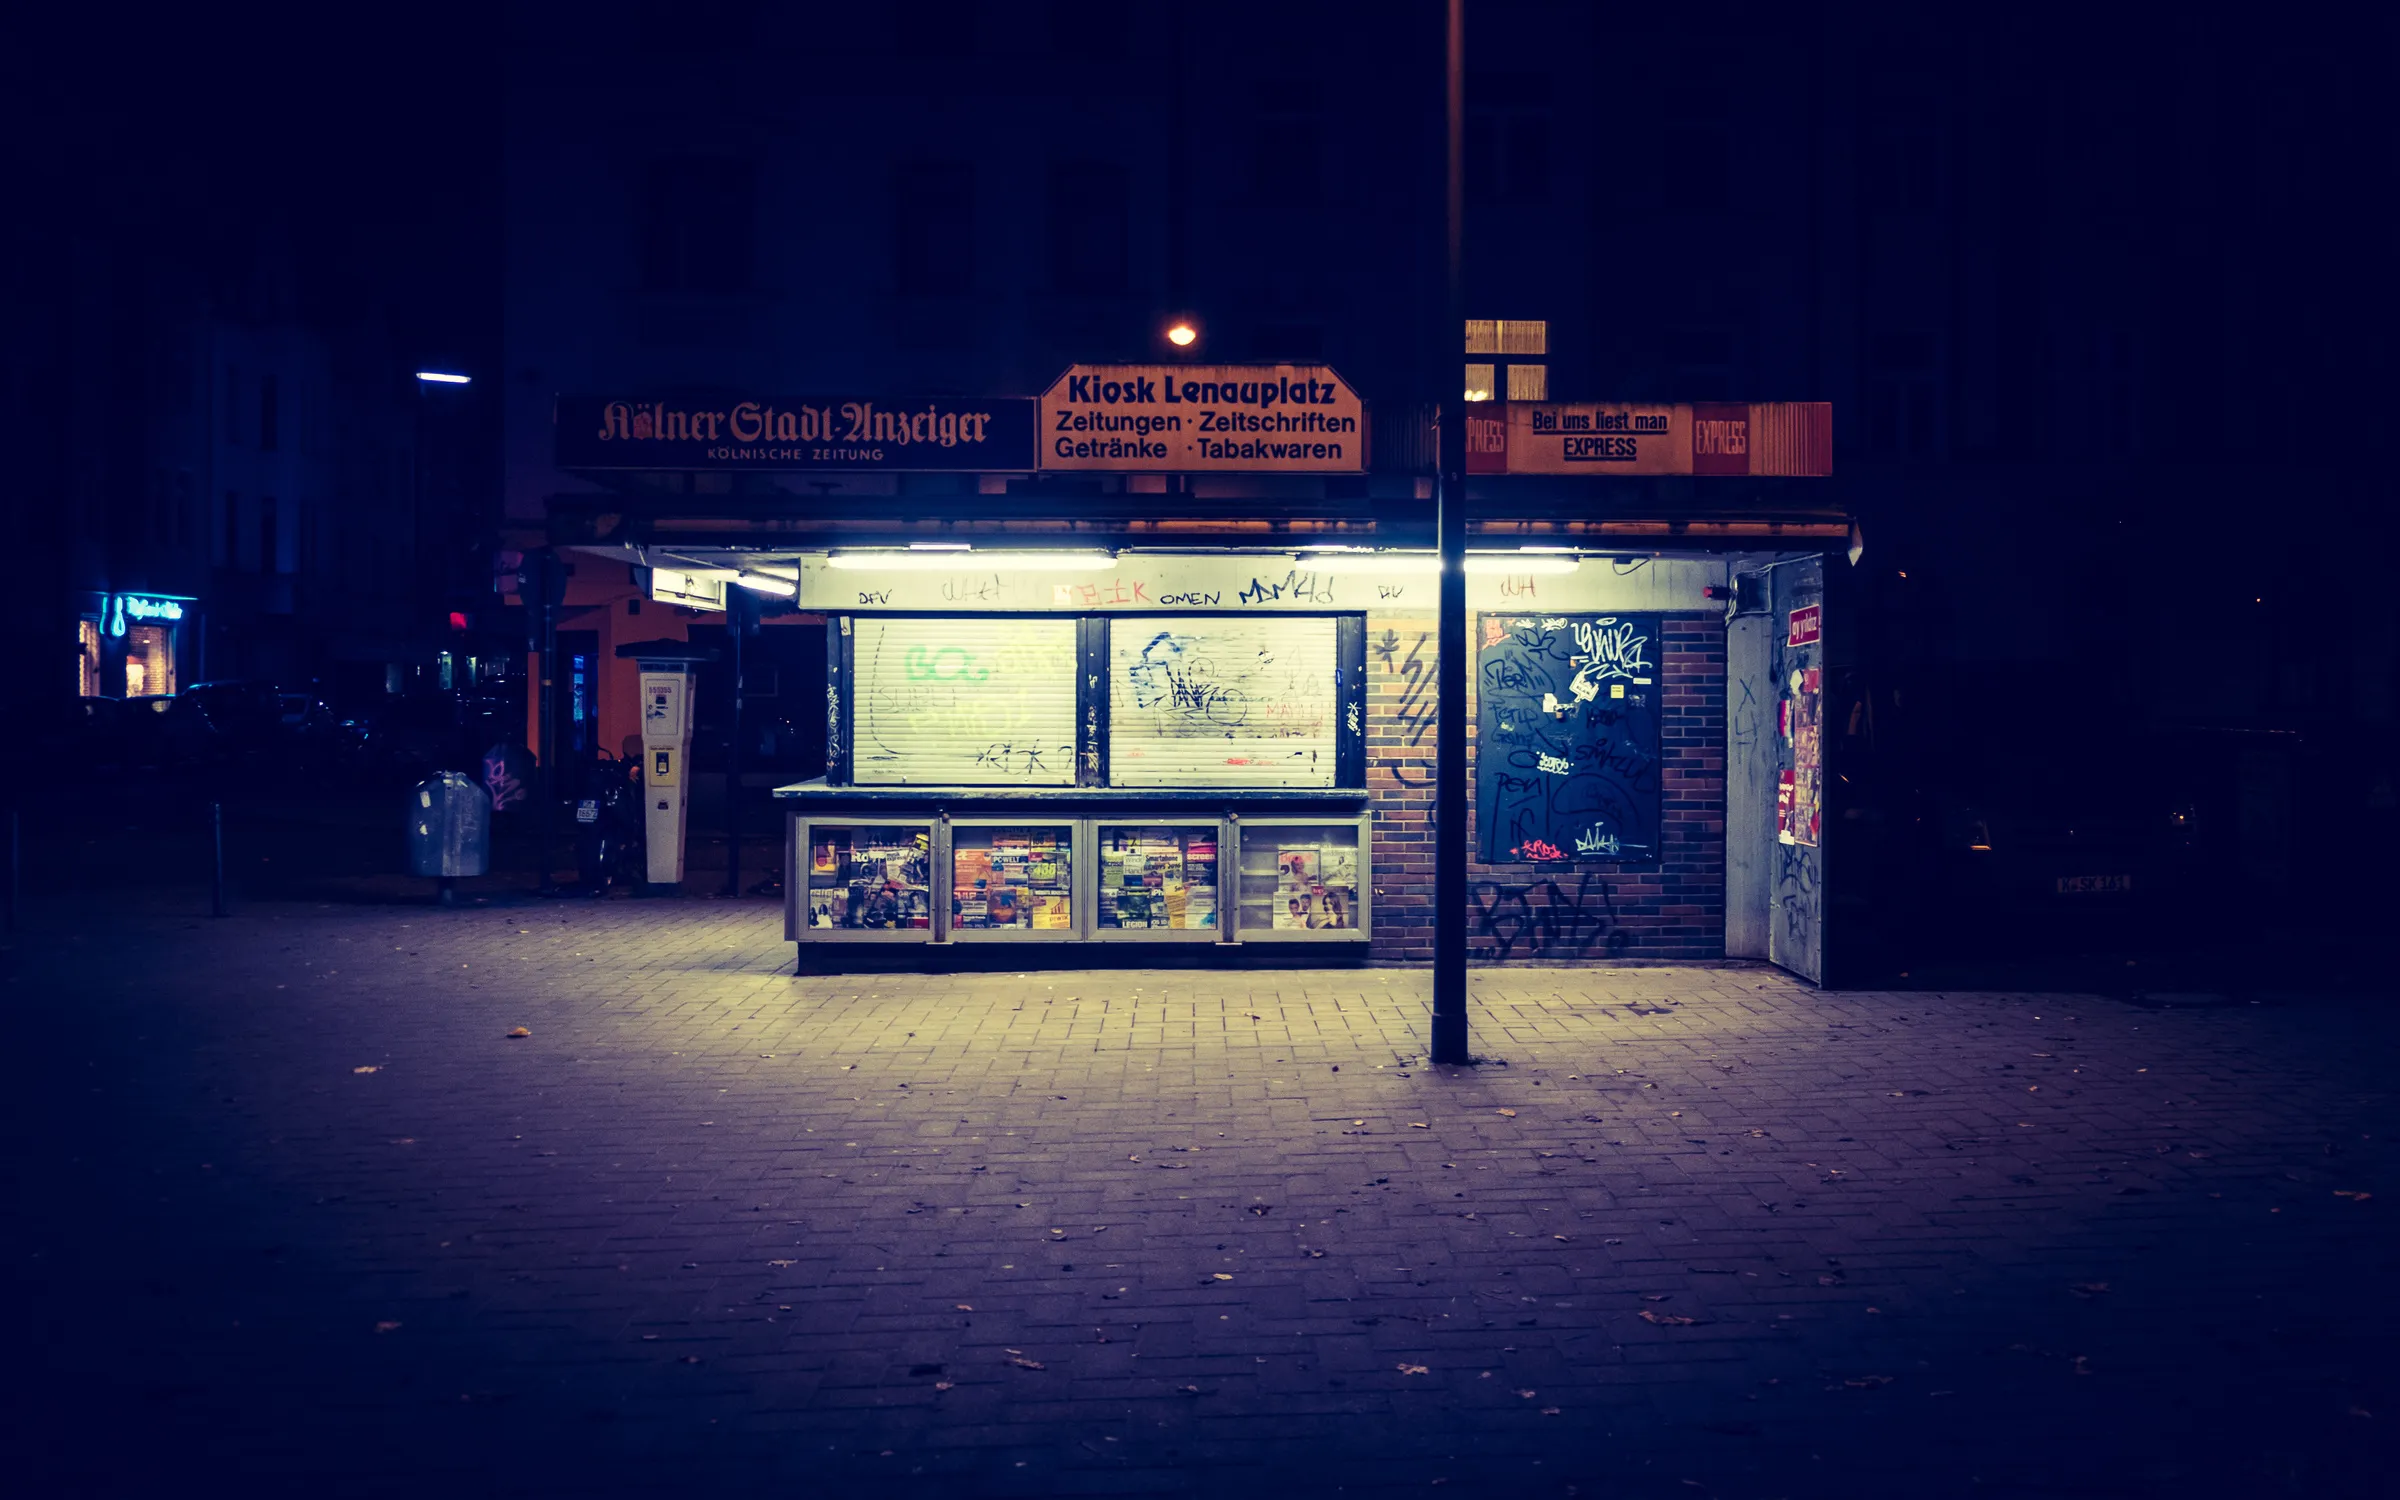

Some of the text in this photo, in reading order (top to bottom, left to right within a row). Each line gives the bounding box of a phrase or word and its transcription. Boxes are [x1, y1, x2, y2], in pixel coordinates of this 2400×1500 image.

[1068, 375, 1336, 409] Kiosk Lenauplatz
[730, 402, 992, 448] Stadt-Anzeiger
[1055, 411, 1356, 436] Zeitungen Zeitschriften
[1532, 411, 1667, 430] Bei uns liest man
[1054, 436, 1342, 459] Getränke Tabakwaren
[1563, 437, 1637, 457] EXPRESS
[1696, 420, 1747, 454] EXPRESS
[707, 446, 884, 461] KÖLNISCHE ZEITUNG
[1160, 591, 1220, 606] OMEN
